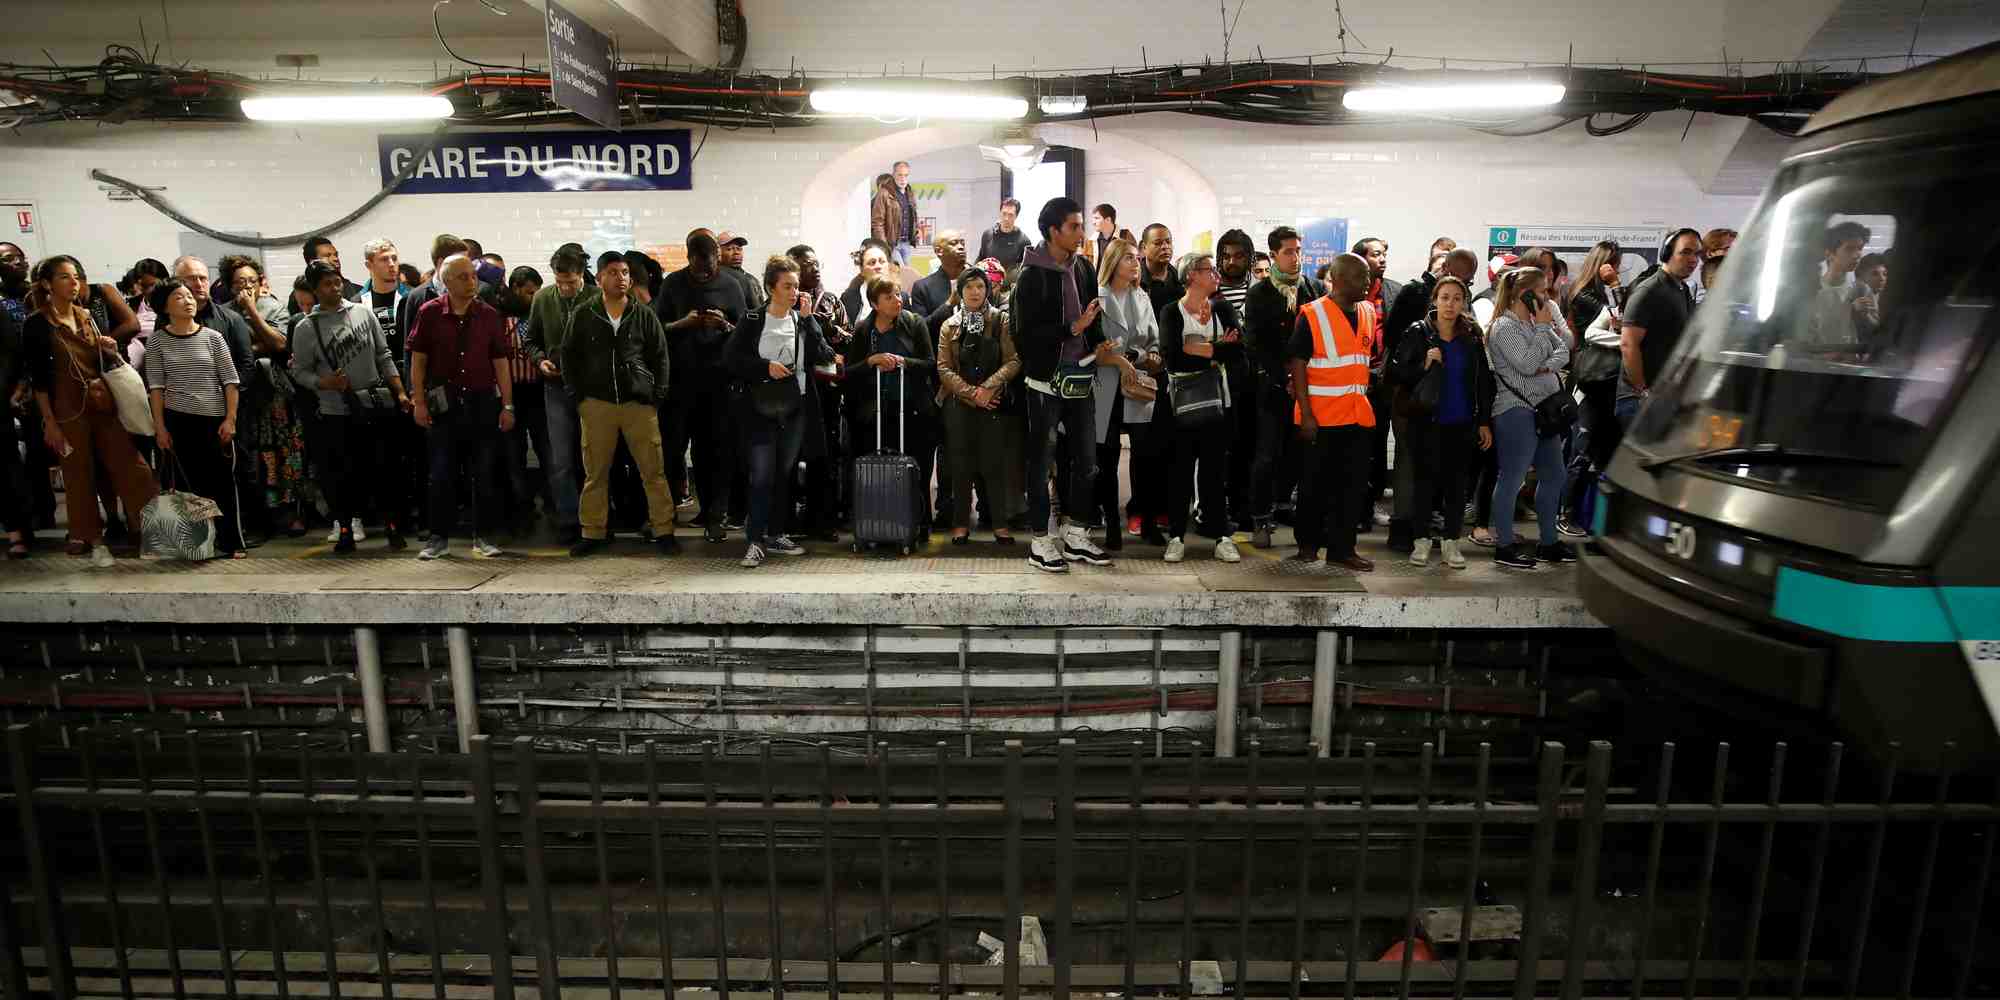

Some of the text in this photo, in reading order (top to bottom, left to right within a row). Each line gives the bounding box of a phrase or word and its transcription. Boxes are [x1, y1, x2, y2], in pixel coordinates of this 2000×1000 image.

[549, 9, 576, 46] Sortie
[389, 144, 681, 179] GARE DU NORD
